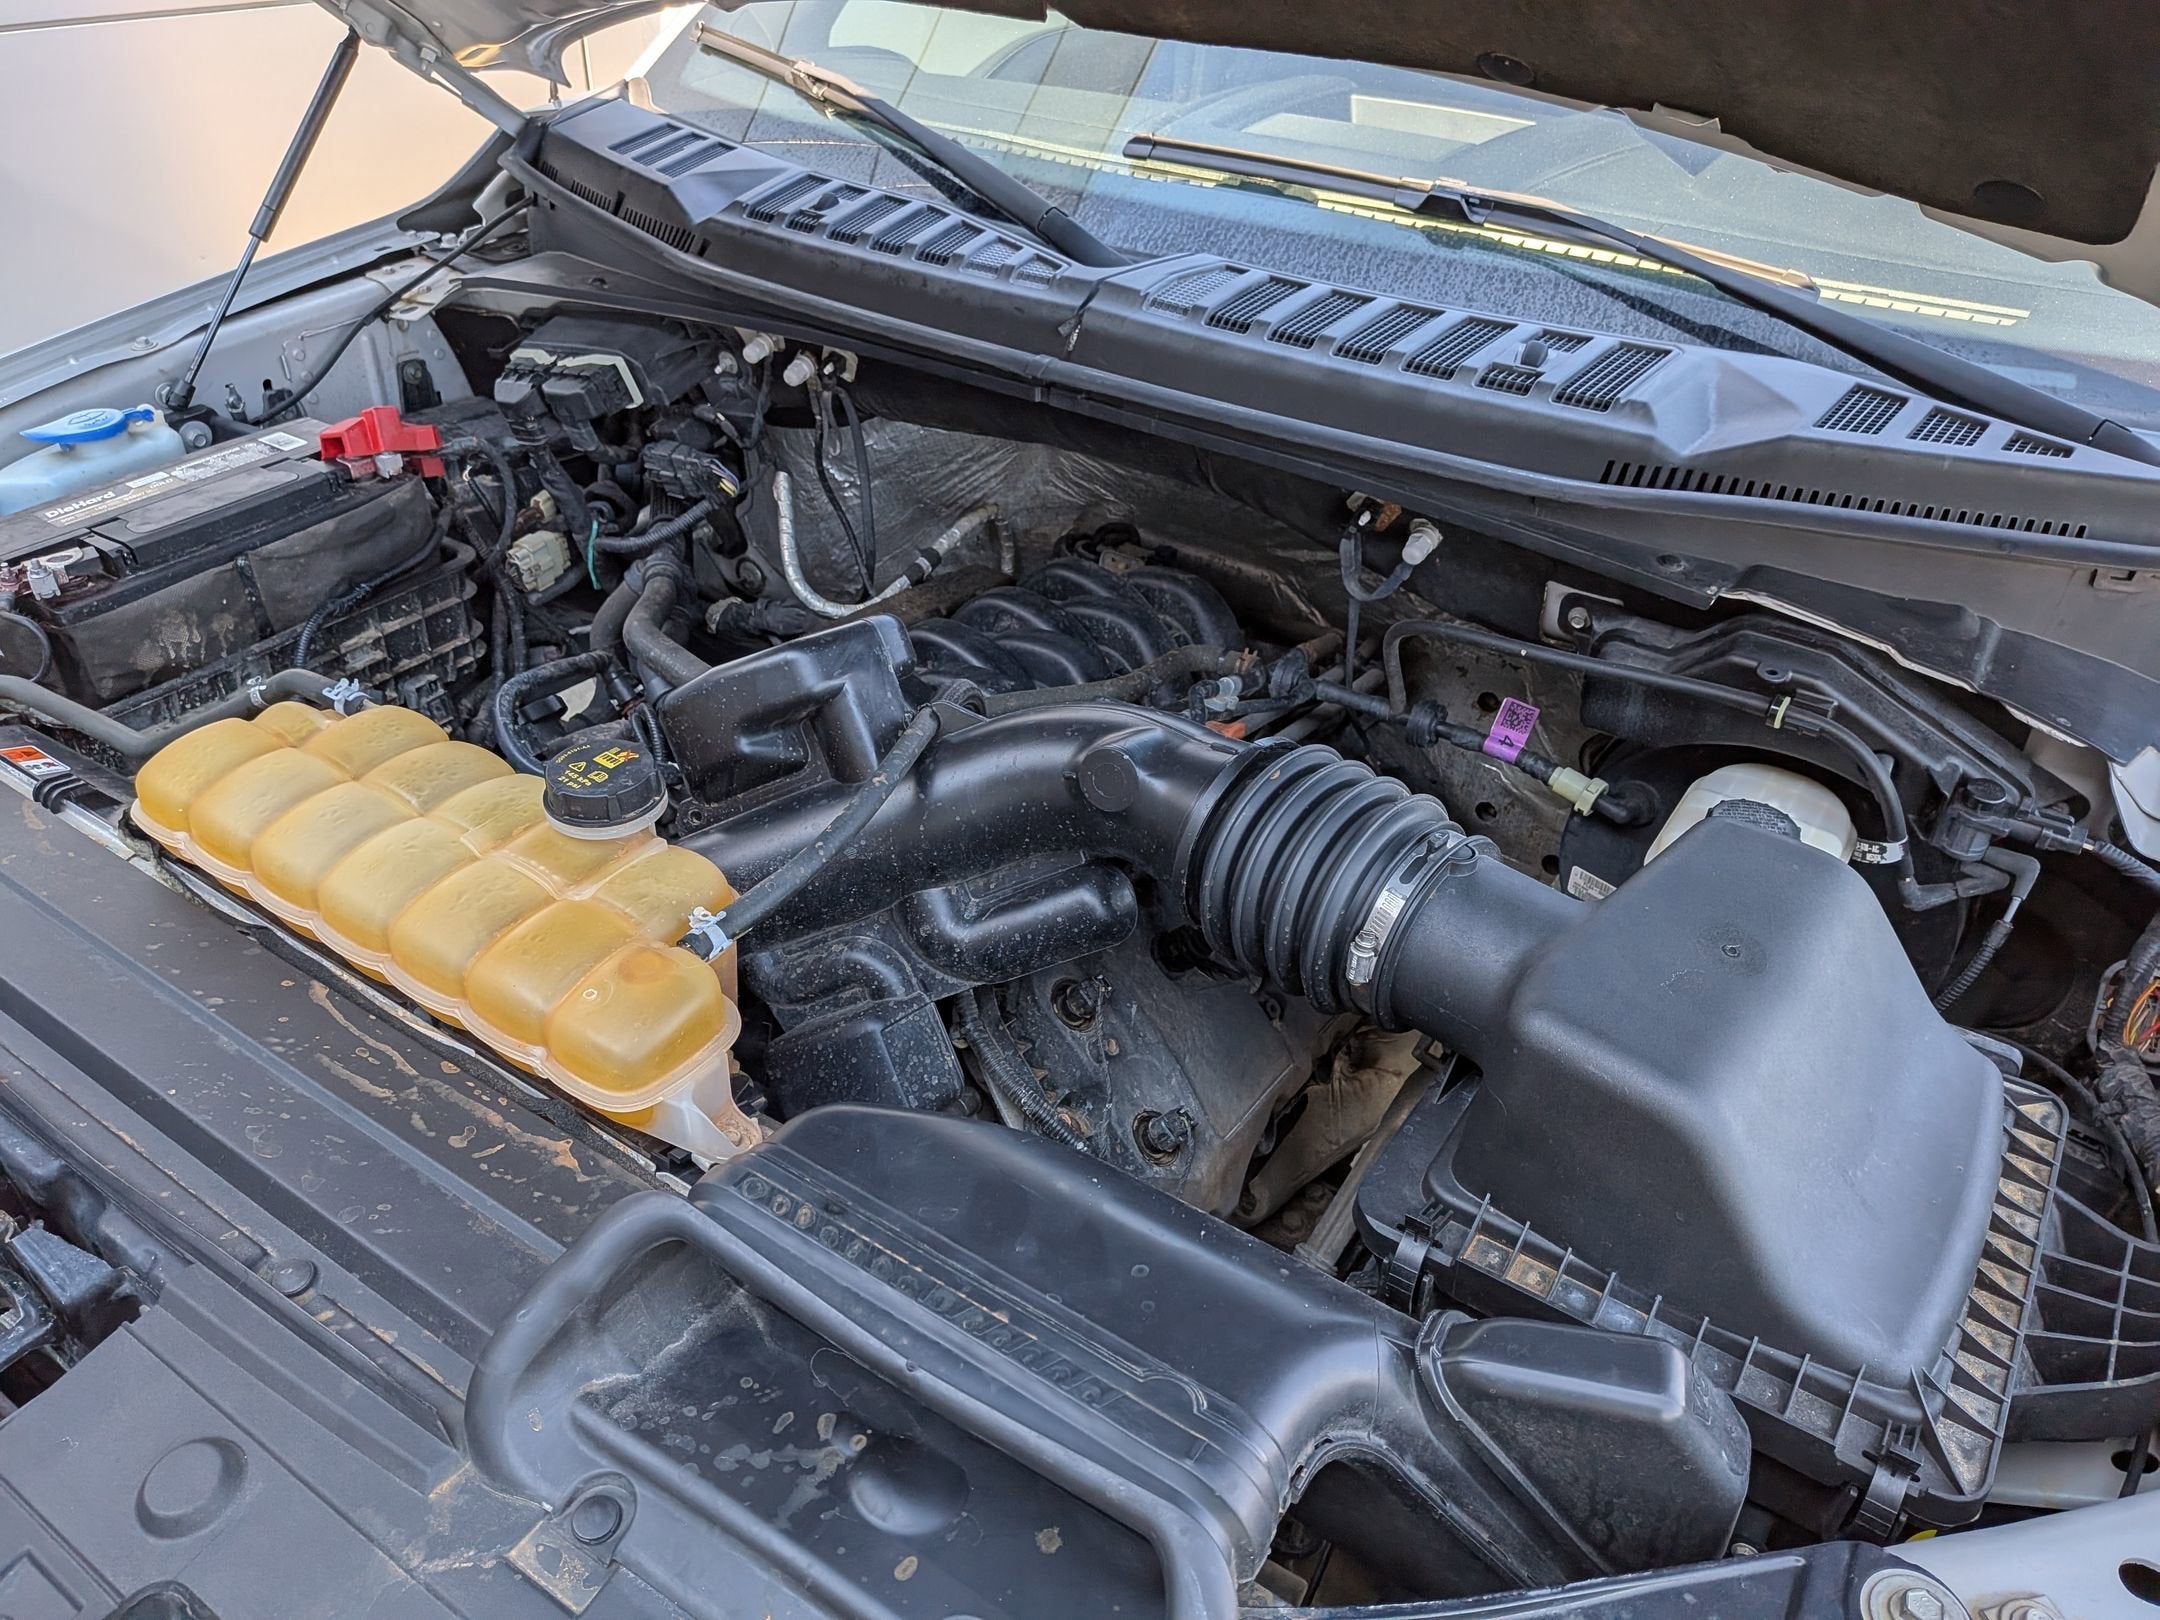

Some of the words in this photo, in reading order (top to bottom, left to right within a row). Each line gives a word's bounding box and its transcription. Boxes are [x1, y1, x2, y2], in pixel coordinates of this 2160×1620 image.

[44, 491, 117, 519] DieHard
[1498, 735, 1515, 747] 4
[564, 769, 579, 779] 145
